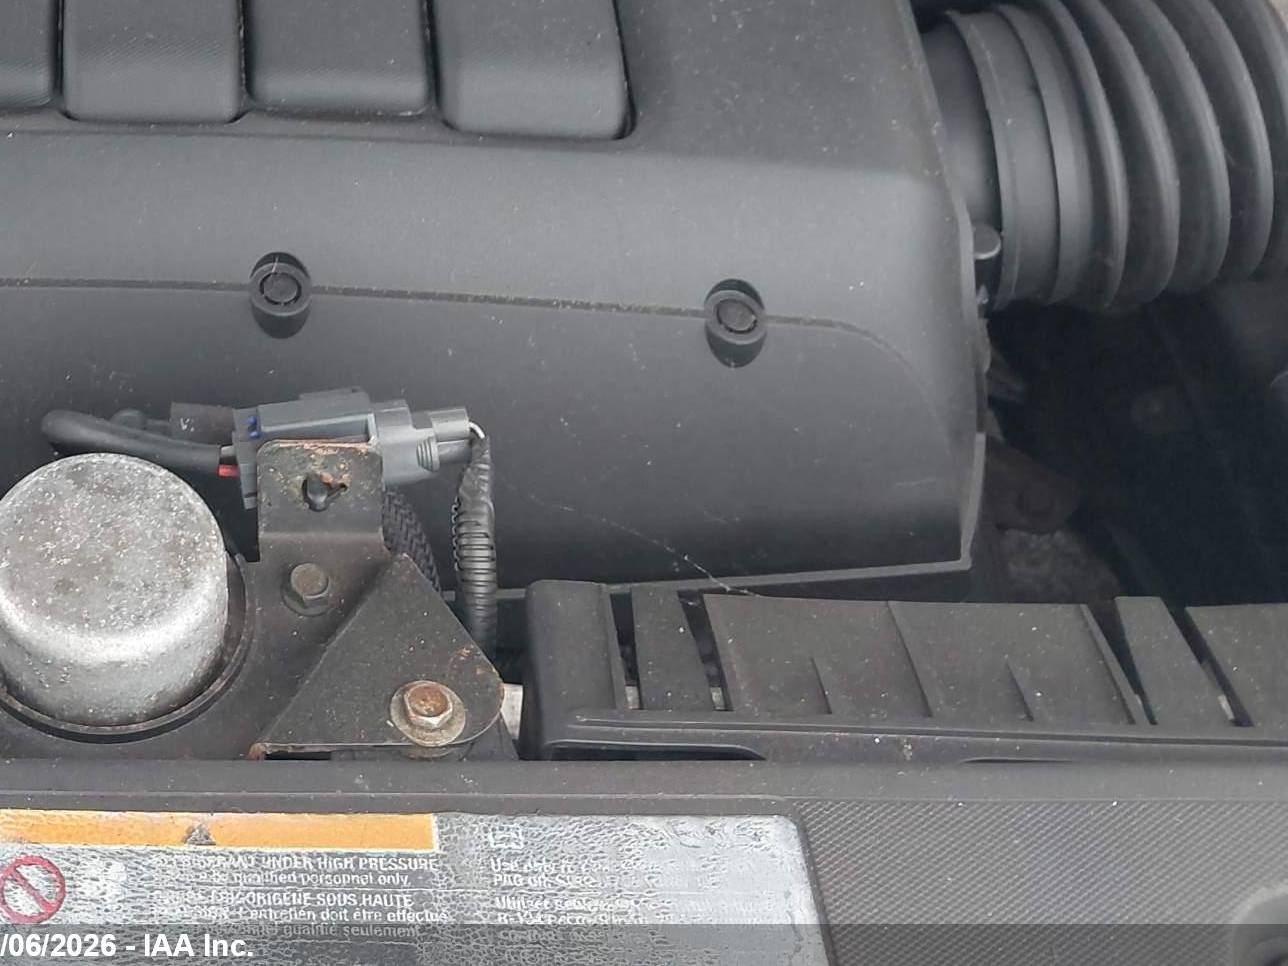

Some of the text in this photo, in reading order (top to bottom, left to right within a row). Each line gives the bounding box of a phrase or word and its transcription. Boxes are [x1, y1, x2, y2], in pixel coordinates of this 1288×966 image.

[263, 855, 314, 870] UNDER
[317, 857, 355, 871] HIGH
[358, 857, 439, 872] PRESSURE
[300, 873, 373, 886] personnel
[316, 893, 358, 907] SOUS
[362, 893, 414, 908] HAUTE
[320, 908, 350, 922] doit
[353, 907, 382, 922] être
